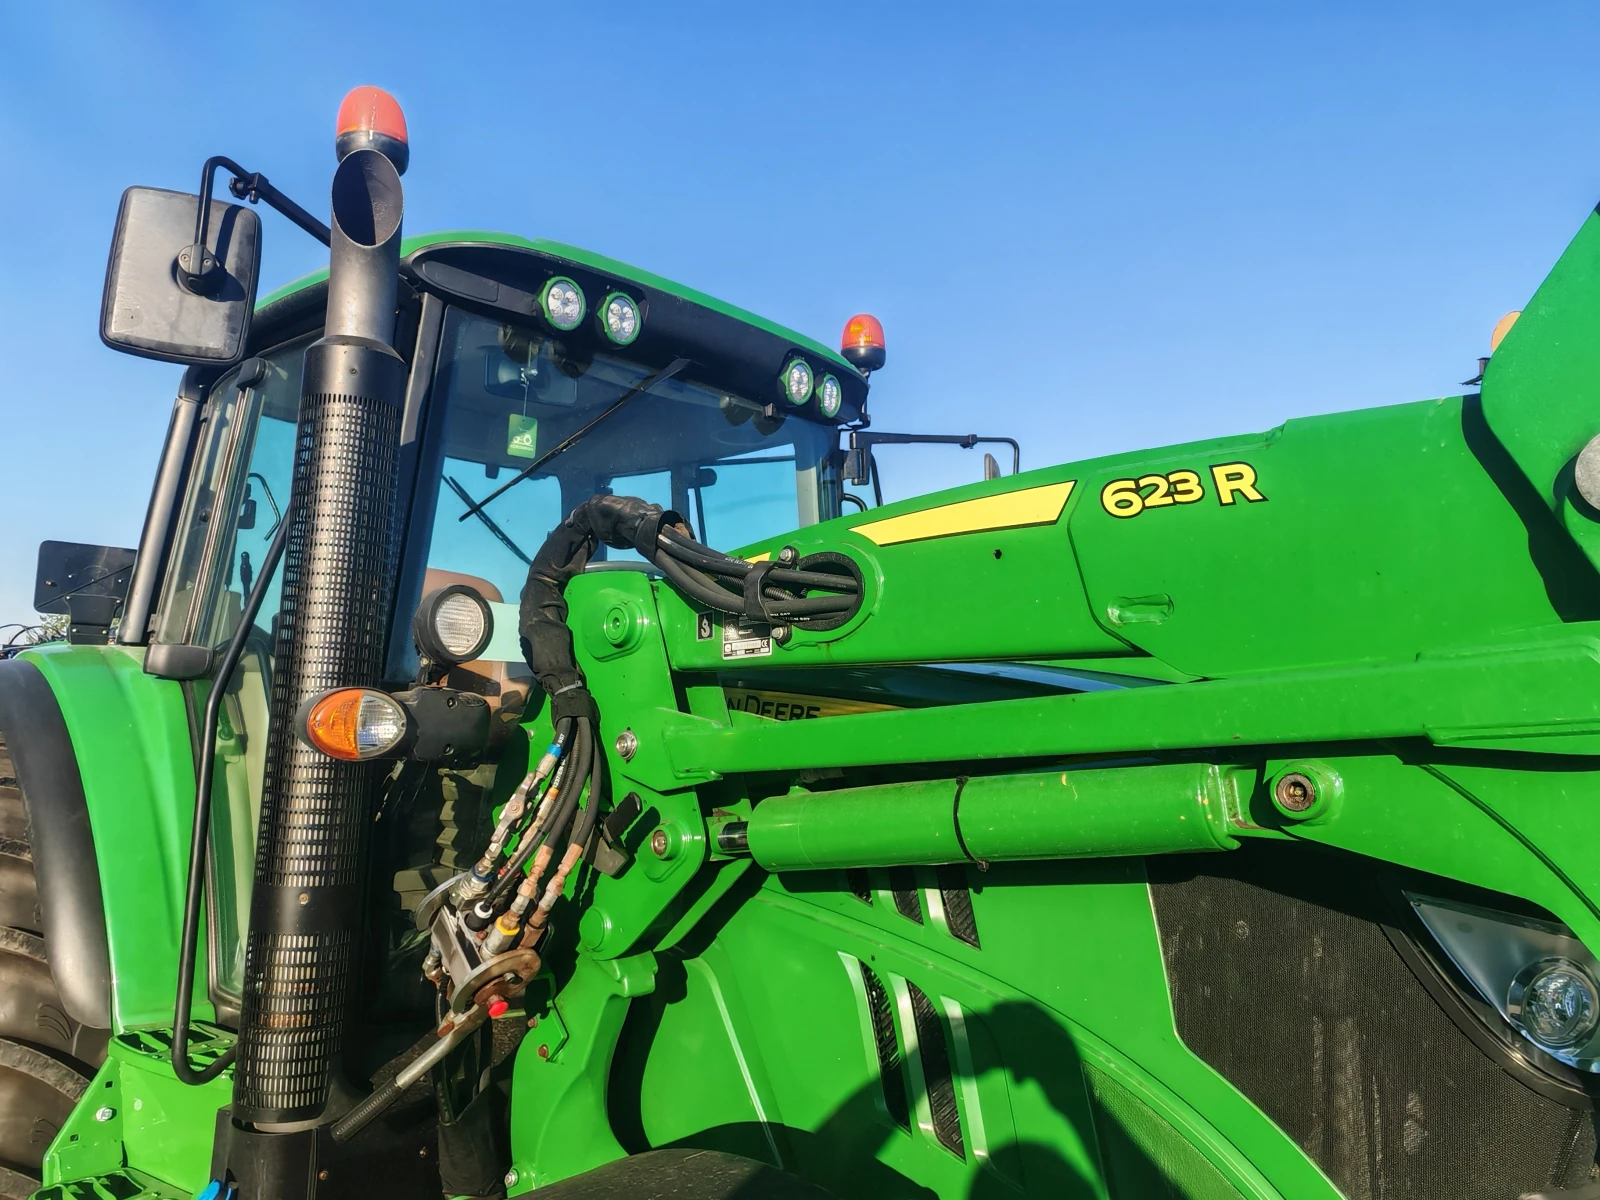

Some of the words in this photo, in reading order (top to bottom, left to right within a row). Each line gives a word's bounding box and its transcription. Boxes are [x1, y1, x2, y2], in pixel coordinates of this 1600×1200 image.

[1100, 468, 1205, 519] 623
[1209, 461, 1269, 506] R
[744, 694, 821, 722] DEERE
